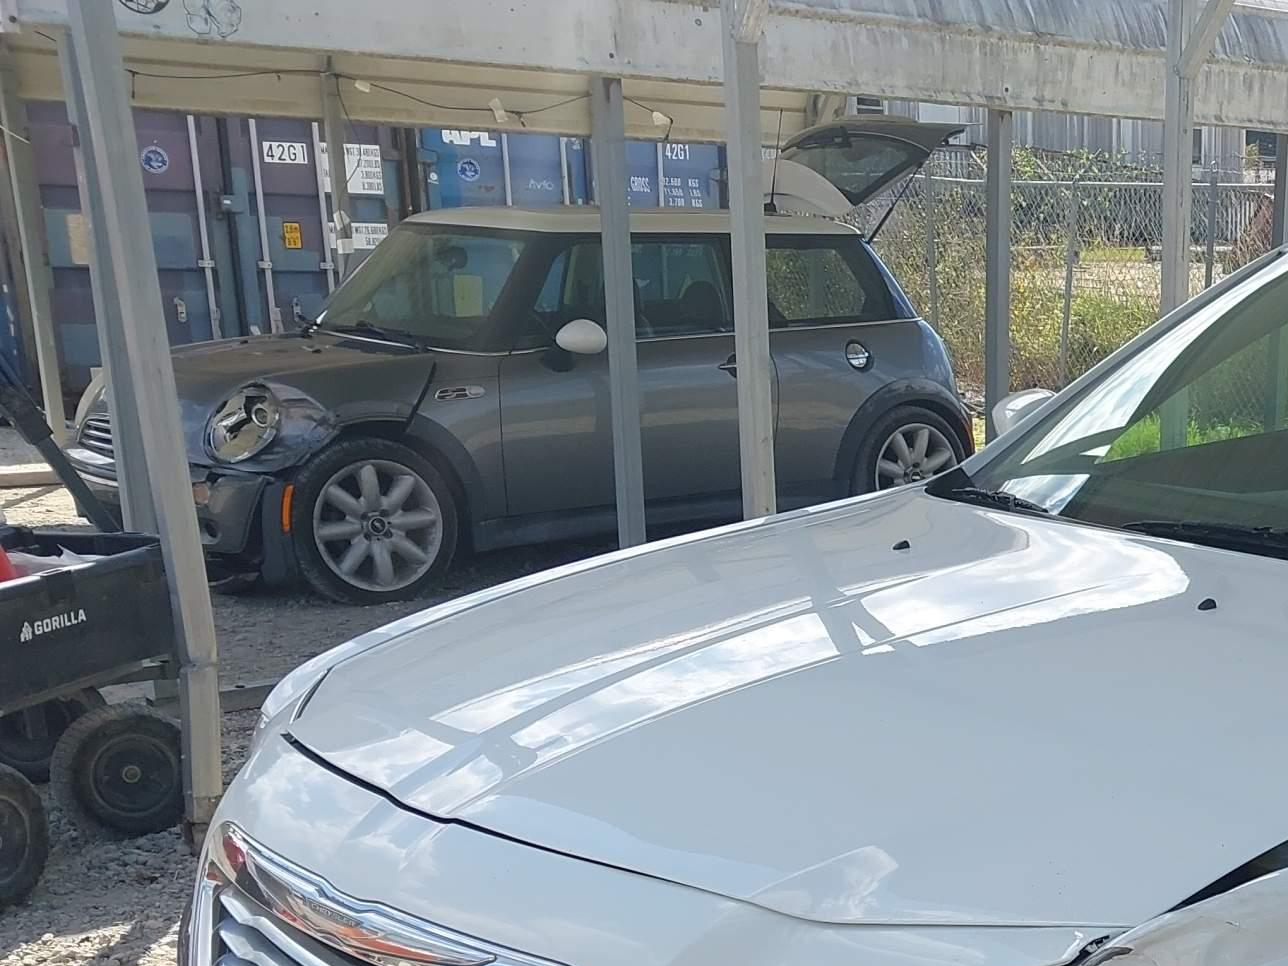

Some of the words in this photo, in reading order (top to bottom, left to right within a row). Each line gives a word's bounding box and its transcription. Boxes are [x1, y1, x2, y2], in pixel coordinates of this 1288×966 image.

[266, 143, 306, 163] 42G1
[665, 143, 690, 160] 42G1
[34, 608, 87, 636] GORILLA
